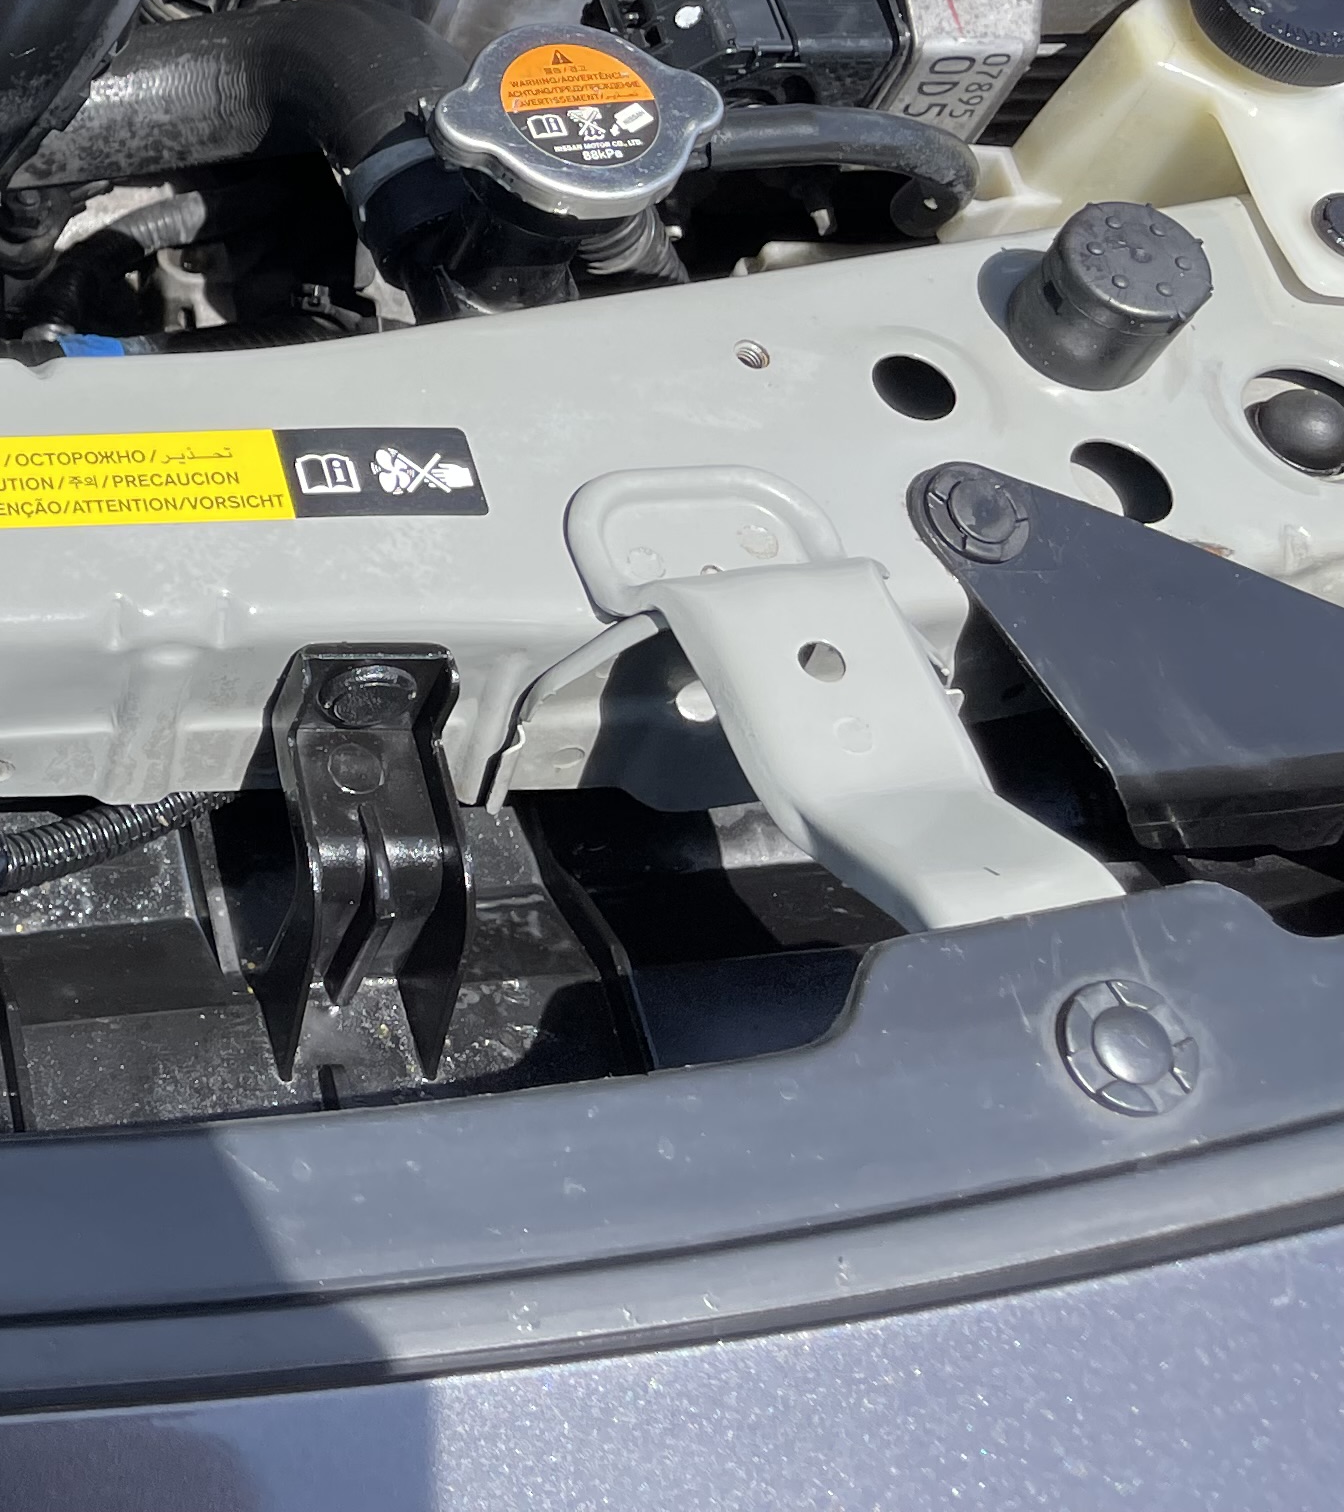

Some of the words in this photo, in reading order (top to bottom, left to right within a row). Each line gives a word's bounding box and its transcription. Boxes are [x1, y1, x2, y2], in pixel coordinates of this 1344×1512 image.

[584, 141, 611, 150] MOTOR
[582, 148, 624, 161] 88kPa
[15, 450, 146, 468] ОСТОРОЖНО
[68, 475, 99, 490] 주의
[113, 471, 240, 489] PRECAUCION
